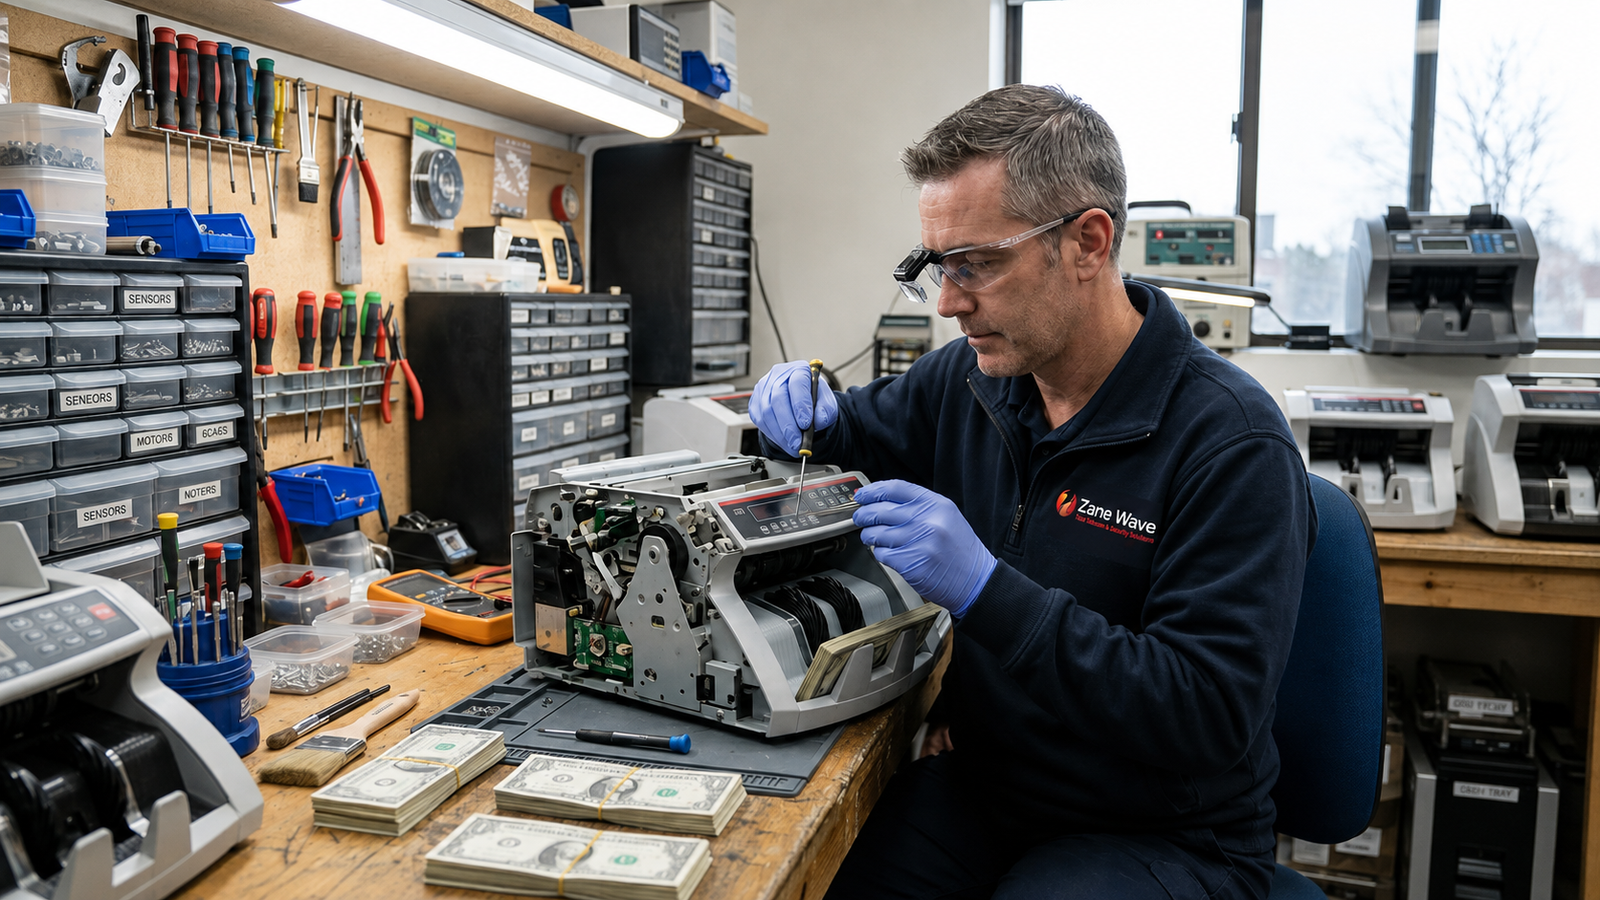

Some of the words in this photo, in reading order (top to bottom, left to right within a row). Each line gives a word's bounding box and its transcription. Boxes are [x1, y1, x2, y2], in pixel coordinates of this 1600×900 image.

[128, 294, 172, 304] SENSORS
[65, 392, 113, 406] SENEORS
[184, 485, 217, 499] NOTERS
[83, 504, 127, 522] SENSORS
[1077, 498, 1112, 521] Zane
[1116, 509, 1157, 534] Wave
